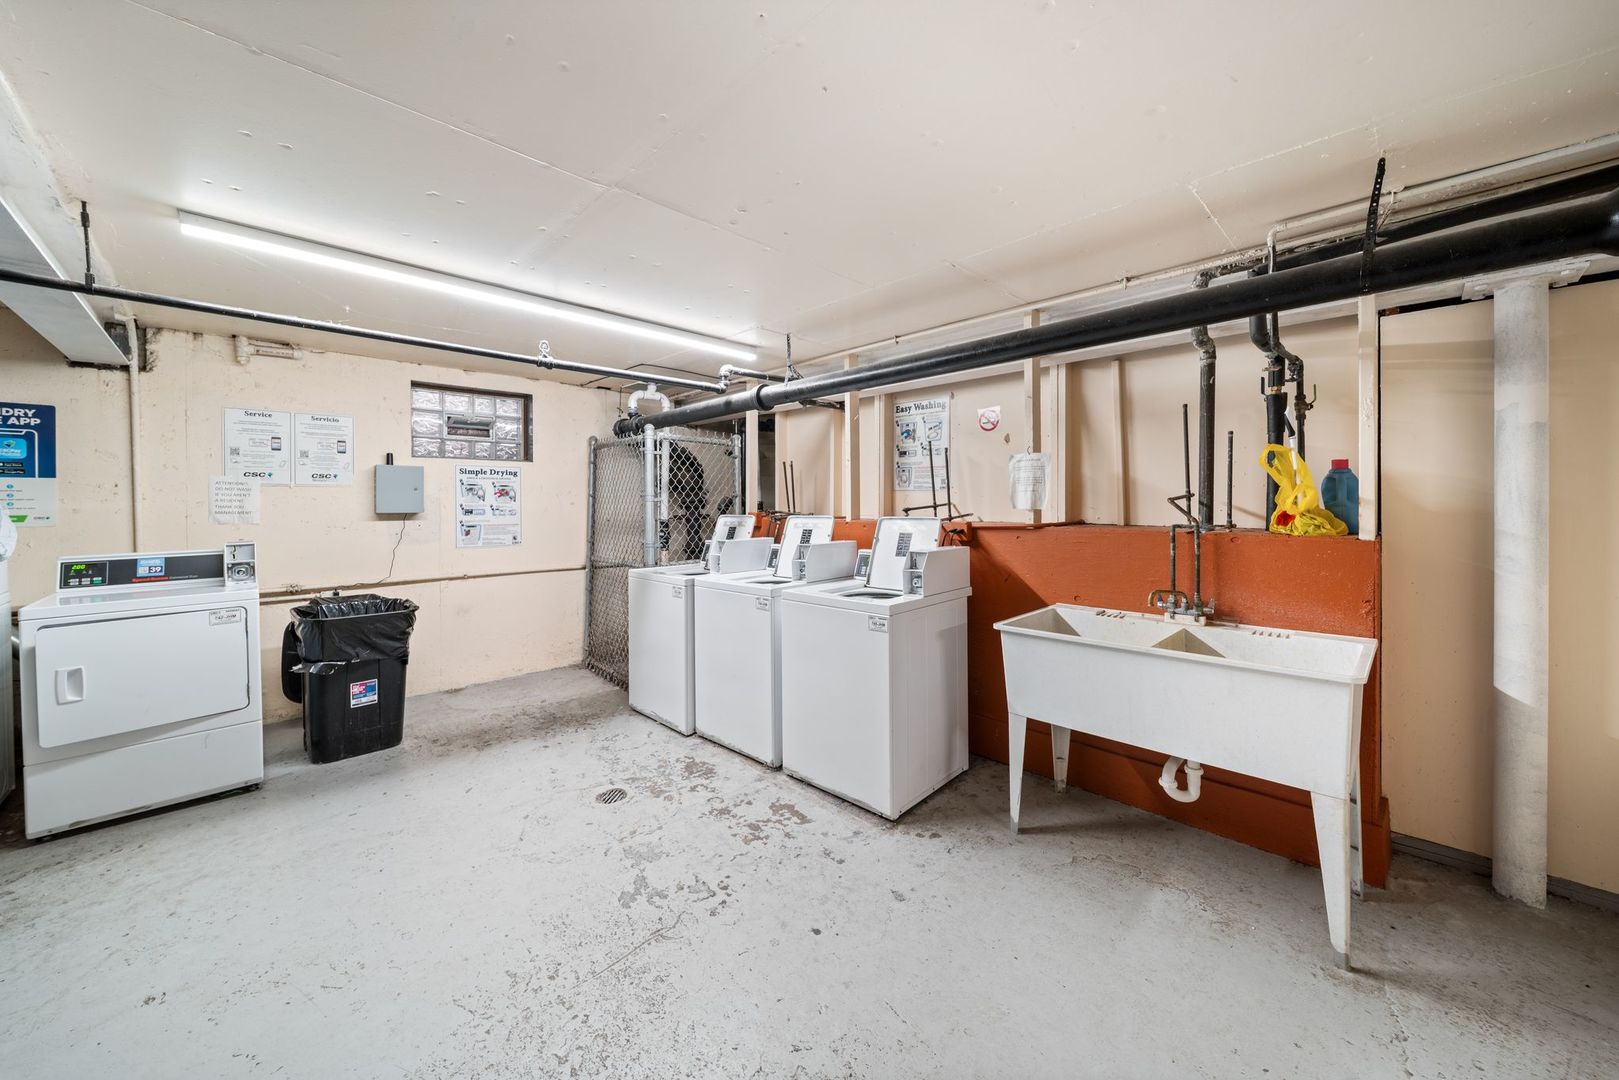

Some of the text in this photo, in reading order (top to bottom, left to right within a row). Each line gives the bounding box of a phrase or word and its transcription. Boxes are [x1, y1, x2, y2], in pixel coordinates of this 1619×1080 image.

[896, 401, 947, 414] Easy Washing
[0, 408, 36, 417] DRY
[244, 410, 272, 418] Service
[7, 417, 41, 425] APP
[311, 415, 340, 423] Servicio
[459, 468, 518, 477] Simple Drying
